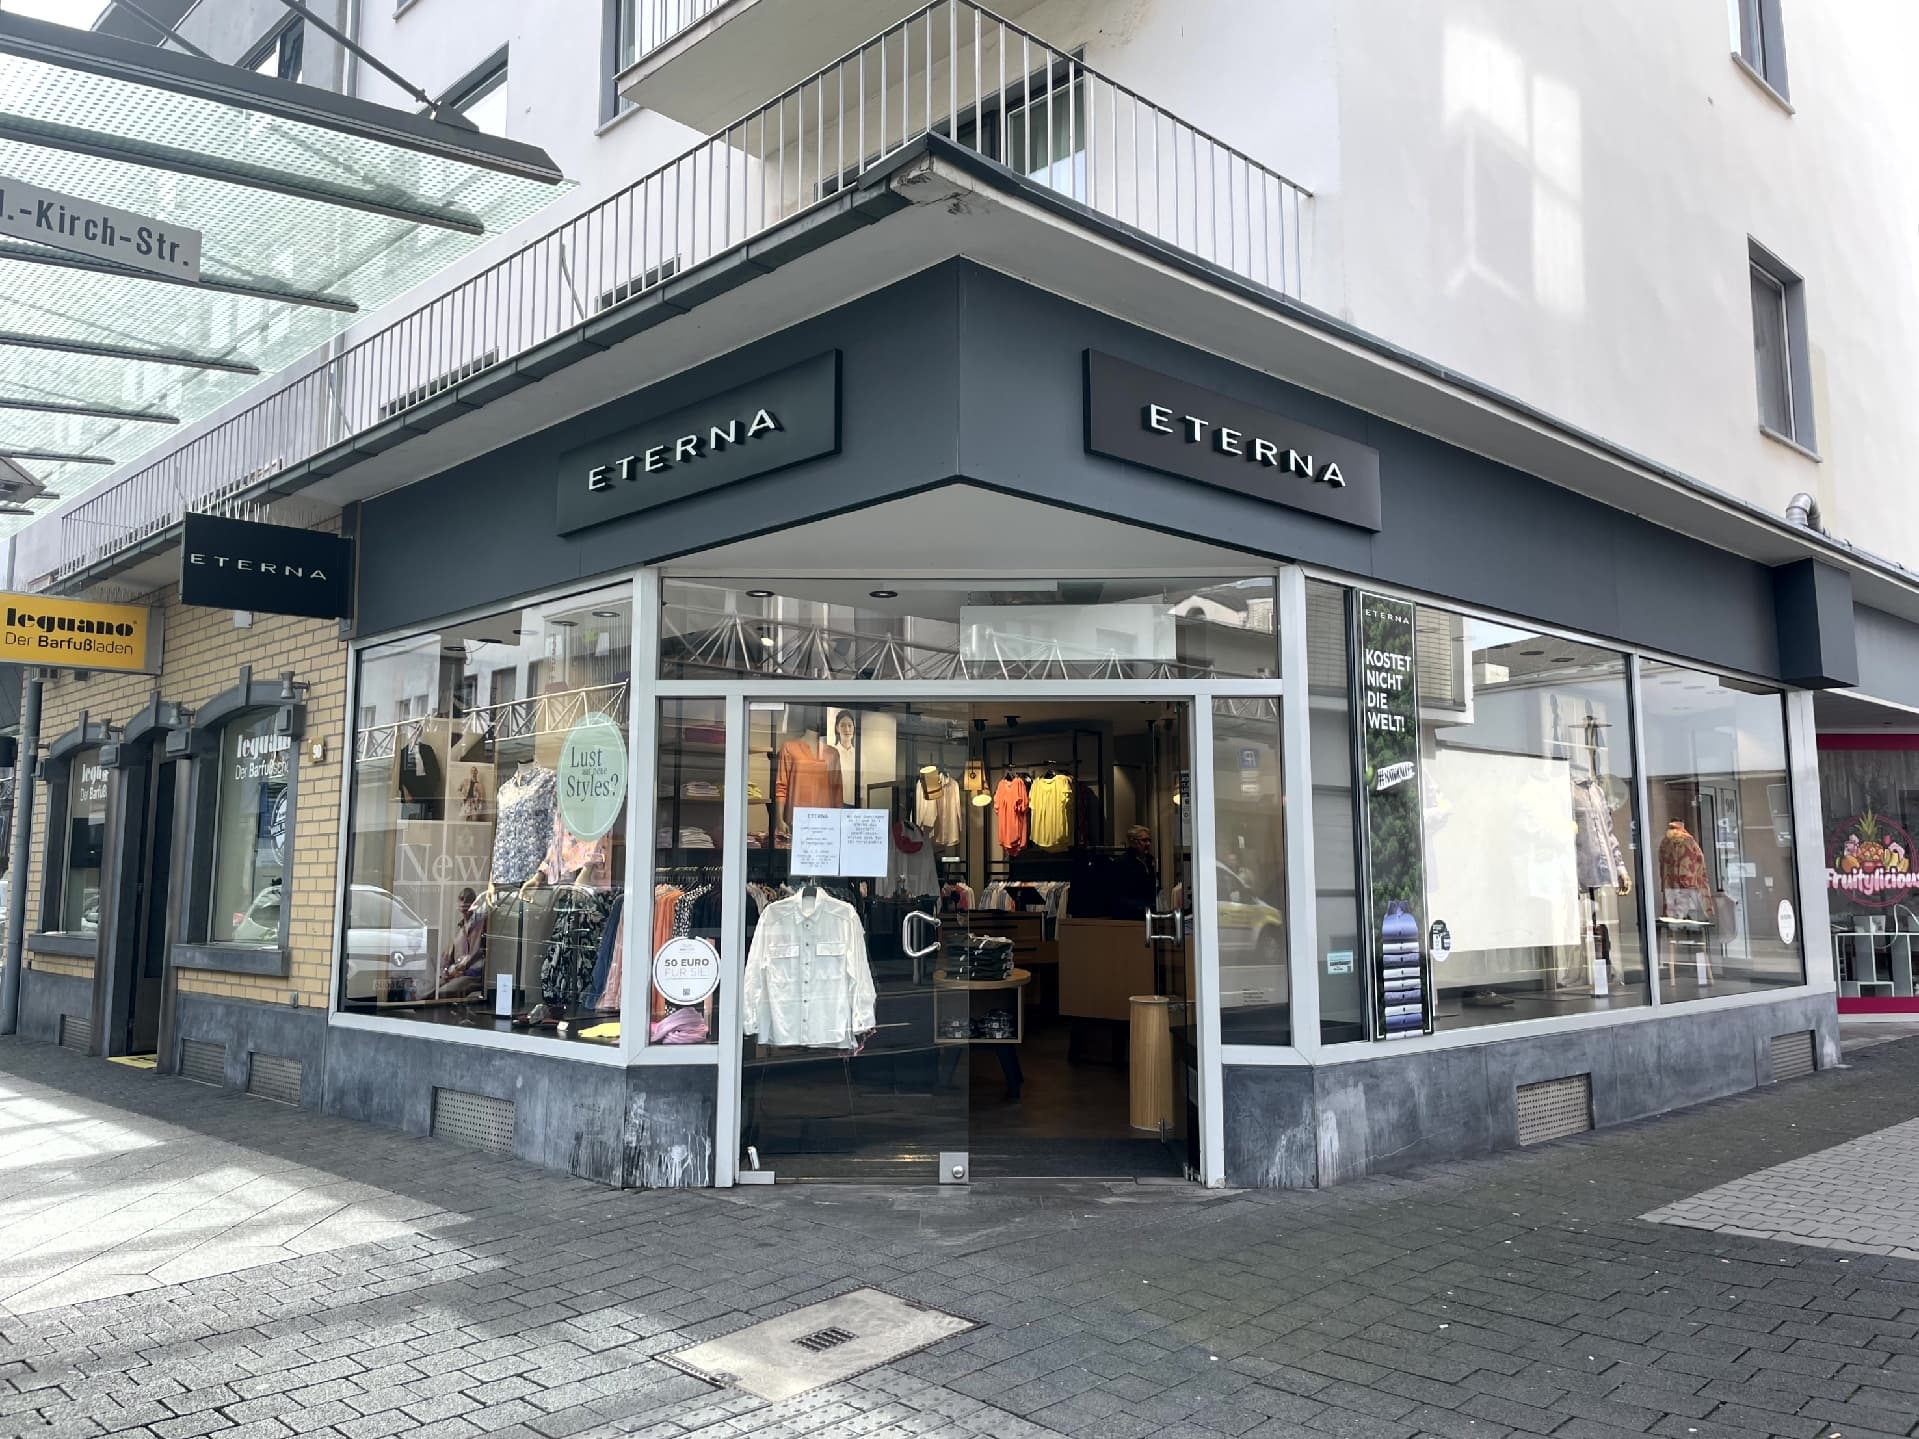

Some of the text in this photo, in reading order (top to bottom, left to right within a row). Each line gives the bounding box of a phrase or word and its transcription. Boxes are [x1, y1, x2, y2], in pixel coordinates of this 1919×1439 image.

[588, 408, 775, 490] ETERNA
[1150, 403, 1346, 487] ETERNA
[190, 553, 327, 581] ETERNA
[7, 607, 134, 637] leguano
[1365, 608, 1410, 625] ETERNA
[5, 631, 133, 656] Der Barfußladen
[1365, 648, 1412, 672] KOSTET
[1366, 669, 1404, 691] NICHT
[1367, 690, 1388, 709] DIE
[1368, 711, 1406, 732] WELT!
[312, 743, 321, 759] 90
[570, 746, 602, 768] Lust
[234, 764, 247, 780] Der
[566, 773, 619, 802] Styles?
[399, 843, 490, 884] New
[664, 958, 710, 967] 50 EURO
